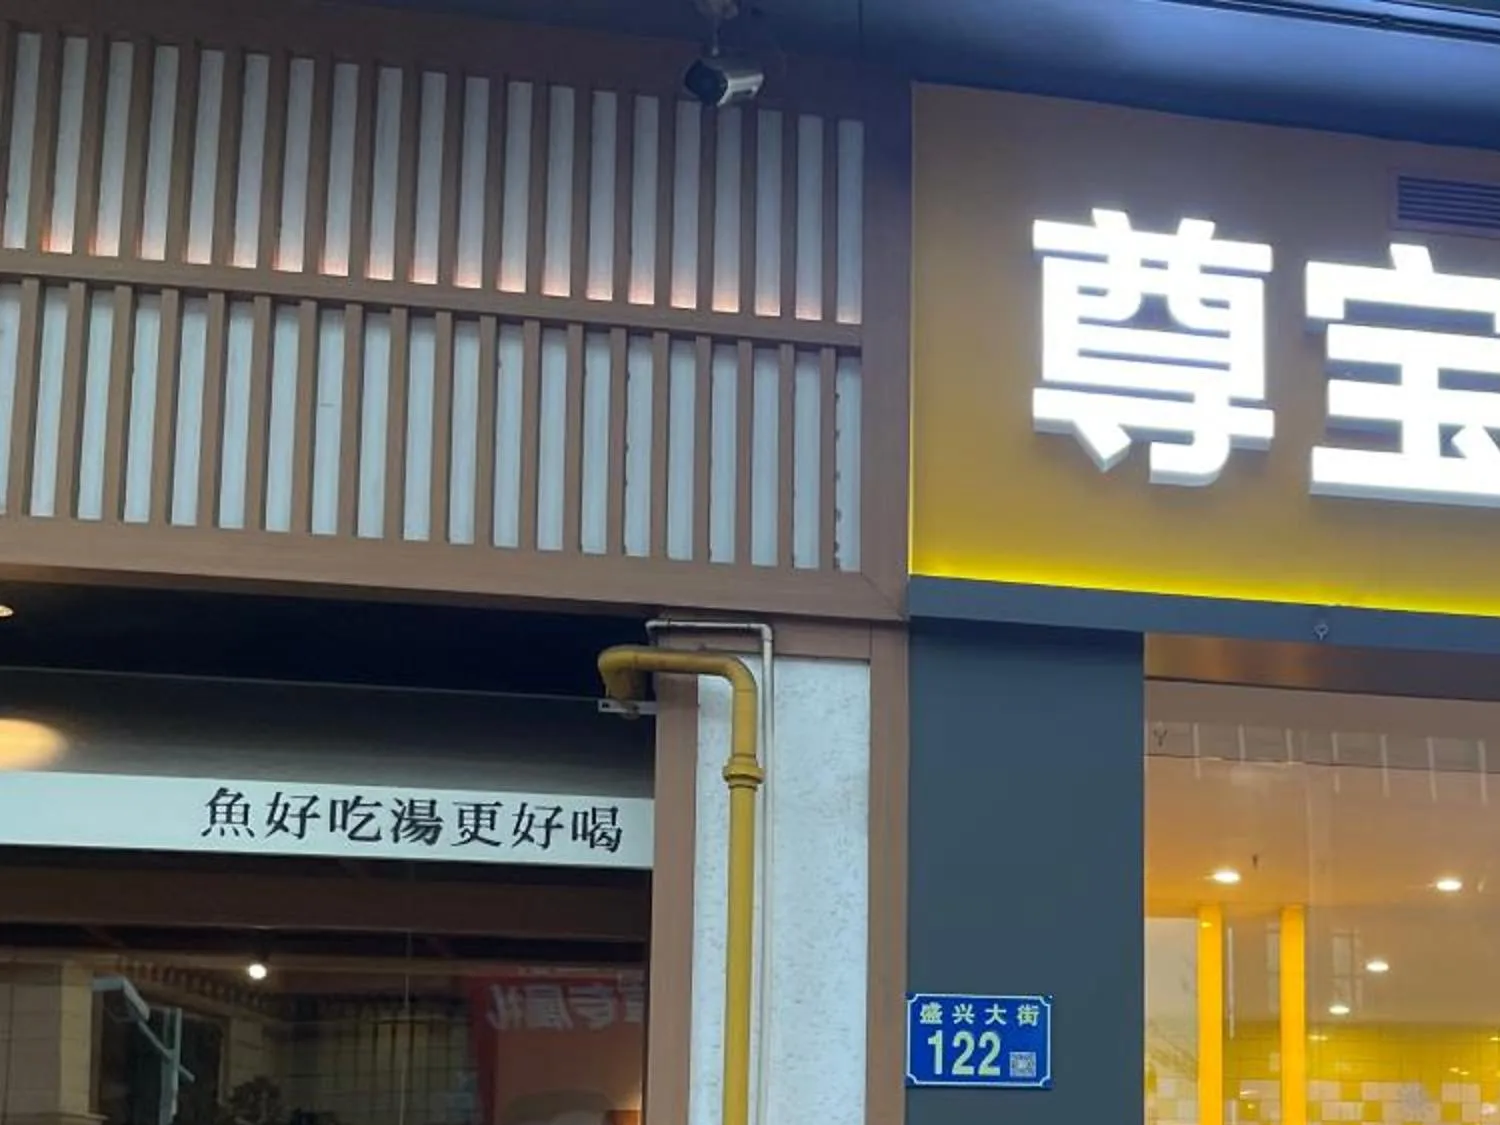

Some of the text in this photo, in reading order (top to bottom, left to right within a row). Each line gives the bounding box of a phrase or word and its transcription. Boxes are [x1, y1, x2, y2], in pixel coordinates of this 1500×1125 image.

[200, 786, 624, 854] 魚好吃湯更好喝
[919, 1002, 1040, 1027] 盛兴大街
[927, 1030, 1001, 1075] 122
